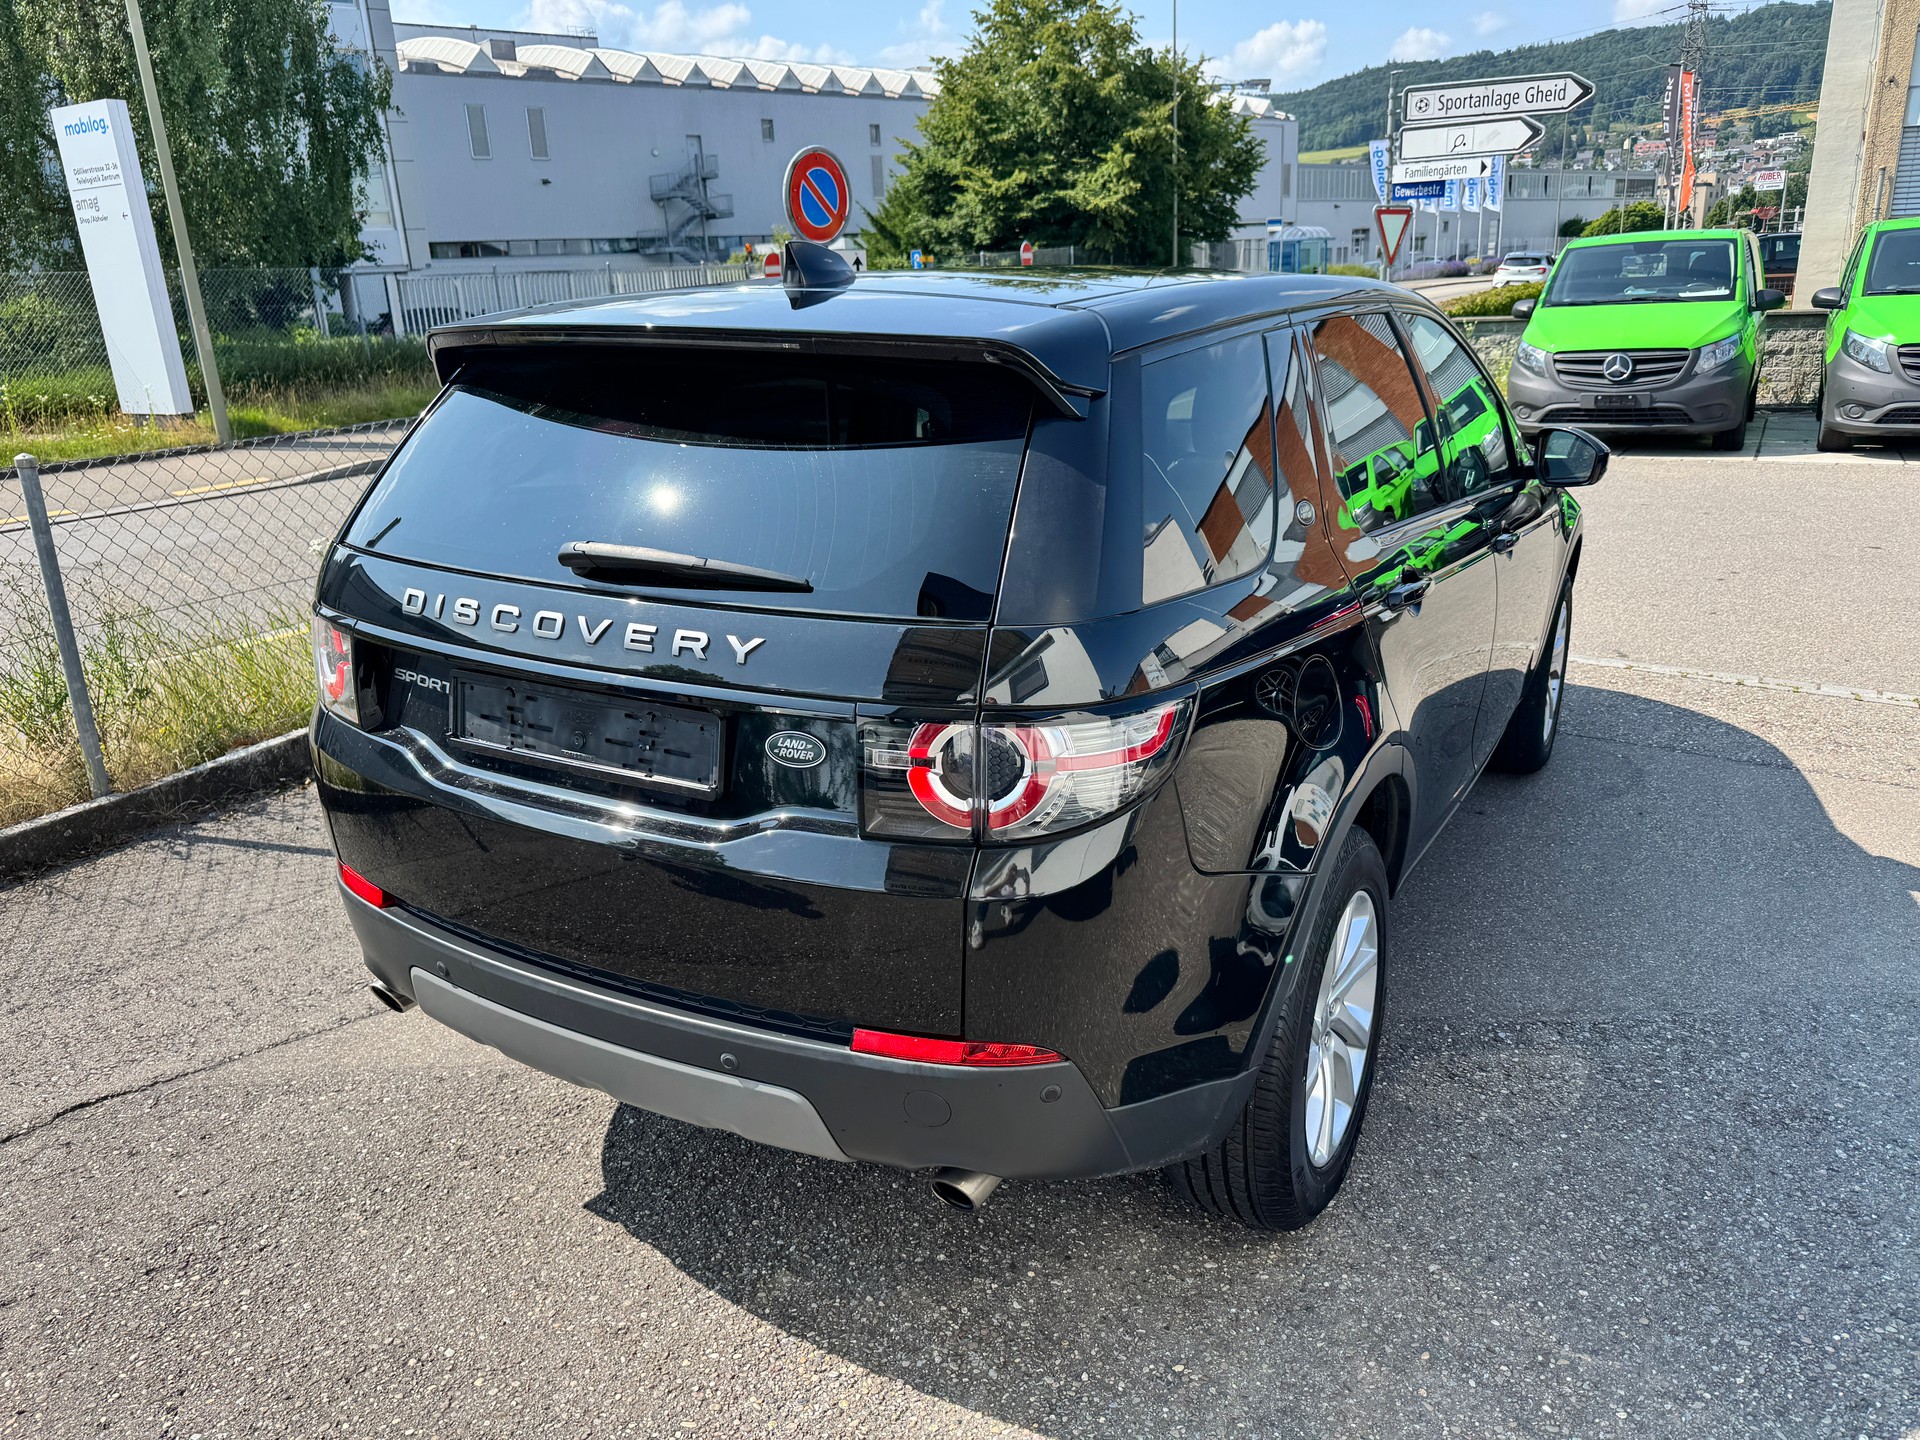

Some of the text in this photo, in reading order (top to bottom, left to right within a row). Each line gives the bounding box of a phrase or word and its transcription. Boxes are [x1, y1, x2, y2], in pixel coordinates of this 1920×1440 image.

[1438, 83, 1567, 115] Sportanlage Gheid
[1404, 164, 1468, 179] Familiengärten
[1757, 171, 1783, 182] HUBER
[1394, 183, 1442, 198] Gewerbestr.
[75, 196, 100, 212] amag
[402, 586, 766, 666] DISCOVERY
[394, 667, 451, 694] SPORT
[777, 737, 807, 750] LAND
[779, 747, 814, 761] ROVER
